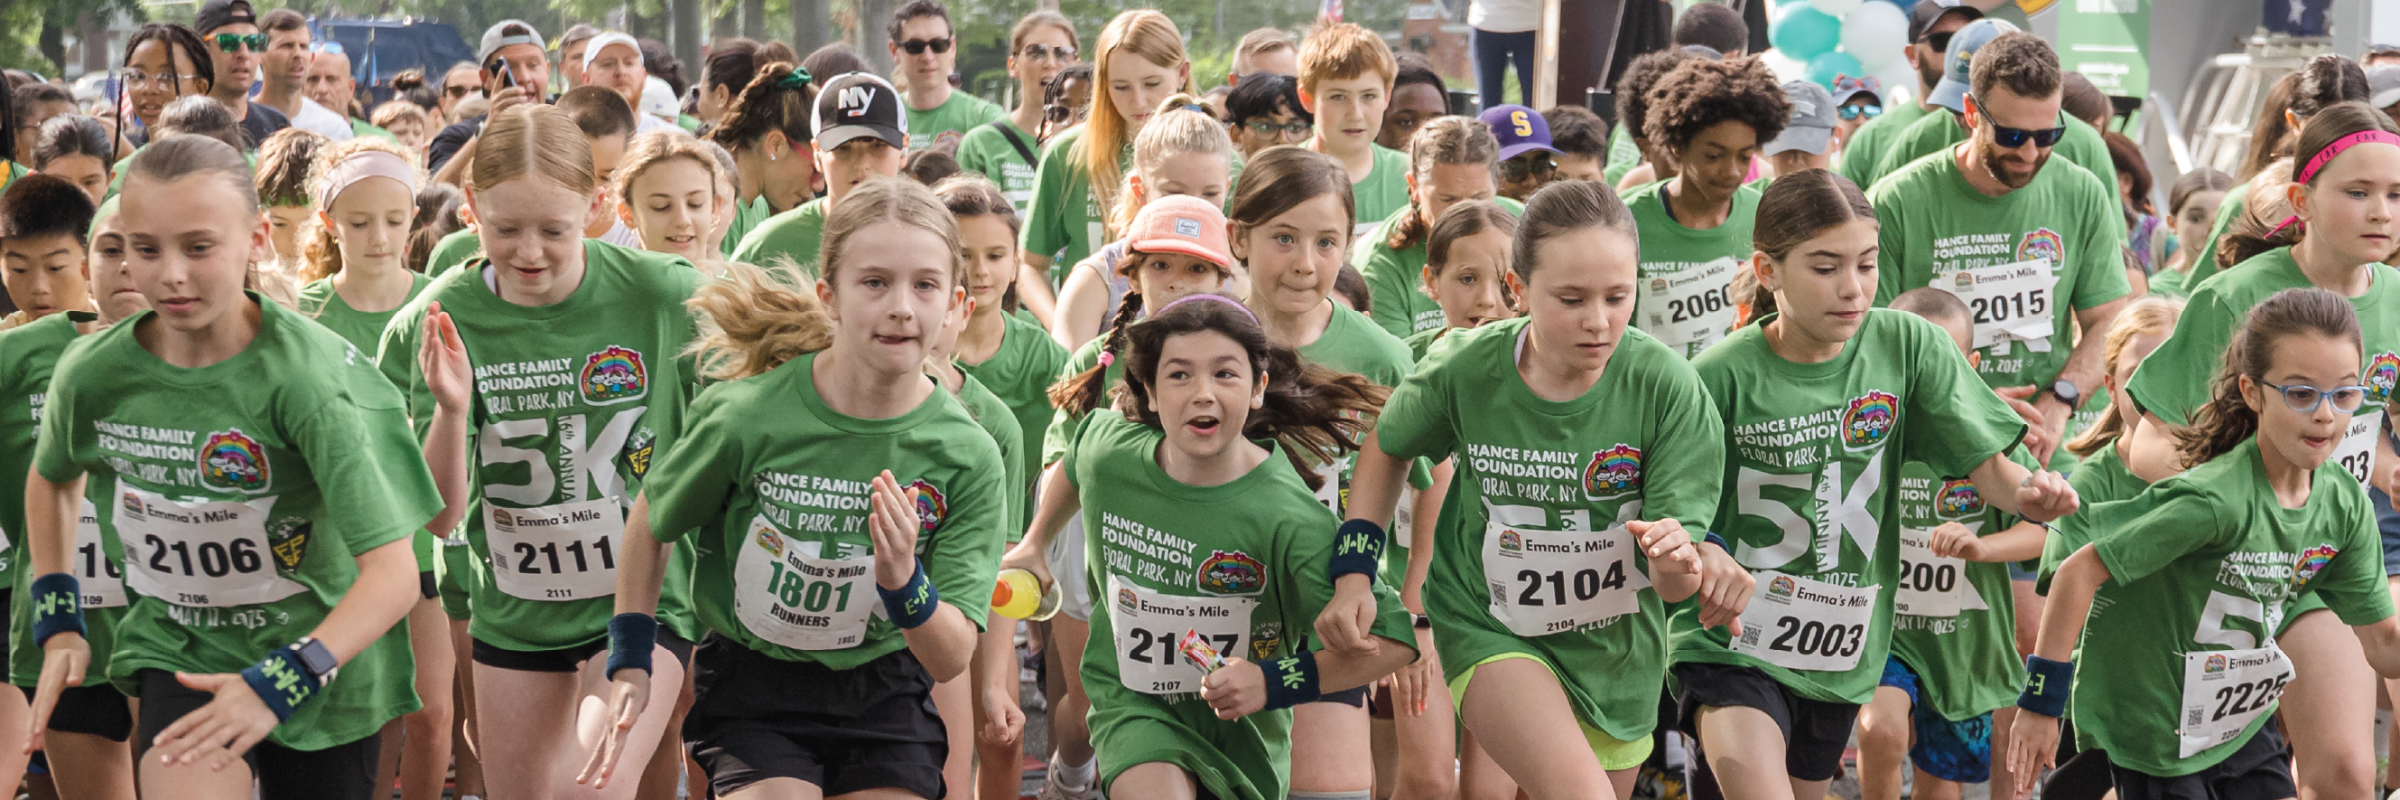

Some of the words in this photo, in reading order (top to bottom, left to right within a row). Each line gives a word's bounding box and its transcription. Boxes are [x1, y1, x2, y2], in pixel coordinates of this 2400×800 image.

[839, 86, 876, 117] NY
[1511, 111, 1532, 136] S
[2356, 133, 2377, 142] EAK
[2319, 145, 2337, 163] EAK
[1933, 243, 2010, 259] FOUNDATION
[1934, 235, 1969, 248] HANCE
[1970, 233, 2011, 244] FAMILY
[1670, 273, 1705, 288] Emma's
[1706, 265, 1725, 277] Mile
[1976, 271, 2015, 284] Emma's
[2016, 268, 2038, 278] Mile
[1668, 283, 1733, 324] 2060
[1970, 289, 2045, 324] 2015
[519, 358, 572, 375] FAMILY
[478, 372, 575, 394] OUNDATION
[516, 394, 555, 411] PARK,
[557, 390, 575, 409] NY
[93, 420, 139, 439] HANCE
[140, 426, 196, 445] FAMILY
[1733, 419, 1786, 436] HANCE
[1789, 408, 1842, 430] FAMILY
[2351, 421, 2367, 437] Mile
[1735, 424, 1838, 447] FOUNDATION
[478, 406, 648, 506] 5K
[1468, 443, 1519, 461] HANCE
[1523, 449, 1579, 465] FAMILY
[1740, 447, 1782, 467] FLORAL
[1785, 445, 1822, 468] PARK,
[175, 467, 197, 487] NY
[560, 447, 576, 503] ANNUA
[1470, 457, 1578, 480] FOUNDATION
[764, 471, 808, 489] ANCE
[811, 476, 873, 495] FAMILY
[1482, 477, 1513, 498] ORAL
[1516, 482, 1555, 504] PARK,
[1560, 484, 1578, 503] NY
[1901, 477, 1931, 489] MILY
[146, 504, 200, 523] Emma's
[204, 509, 238, 523] Mile
[516, 513, 569, 527] Emma's
[571, 509, 601, 522] Mile
[763, 502, 792, 529] ORAL
[797, 513, 838, 533] PARK,
[842, 515, 866, 533] NY
[1733, 446, 1885, 569] 5K
[1915, 504, 1931, 519] NY
[1103, 511, 1144, 537] HANCE
[1146, 527, 1197, 554] FAMILY
[145, 533, 262, 577] 2106
[513, 535, 615, 574] 2111
[1102, 526, 1193, 569] FOUNDATION
[1525, 539, 1581, 553] Emma's
[1585, 539, 1615, 553] Mile
[787, 551, 835, 577] Emma's
[837, 565, 867, 579] Mile
[1137, 559, 1169, 585] PARK,
[1174, 571, 1192, 588] NY
[2220, 560, 2294, 578] FOUNDATIO
[546, 589, 572, 598] 2111
[767, 560, 853, 612] 1801
[1517, 559, 1626, 606] 2104
[81, 595, 103, 604] 109
[178, 593, 209, 604] 2106
[1797, 586, 1846, 607] Emma's
[1847, 595, 1868, 607] Mile
[770, 602, 831, 627] RUNNERS
[1141, 600, 1195, 617] Emma's
[1199, 606, 1230, 617] Mile
[1547, 619, 1575, 631] 2104
[1768, 615, 1864, 657] 2003
[2229, 654, 2271, 670] Emma's
[1152, 681, 1181, 691] 2107
[2211, 670, 2290, 722] 2225
